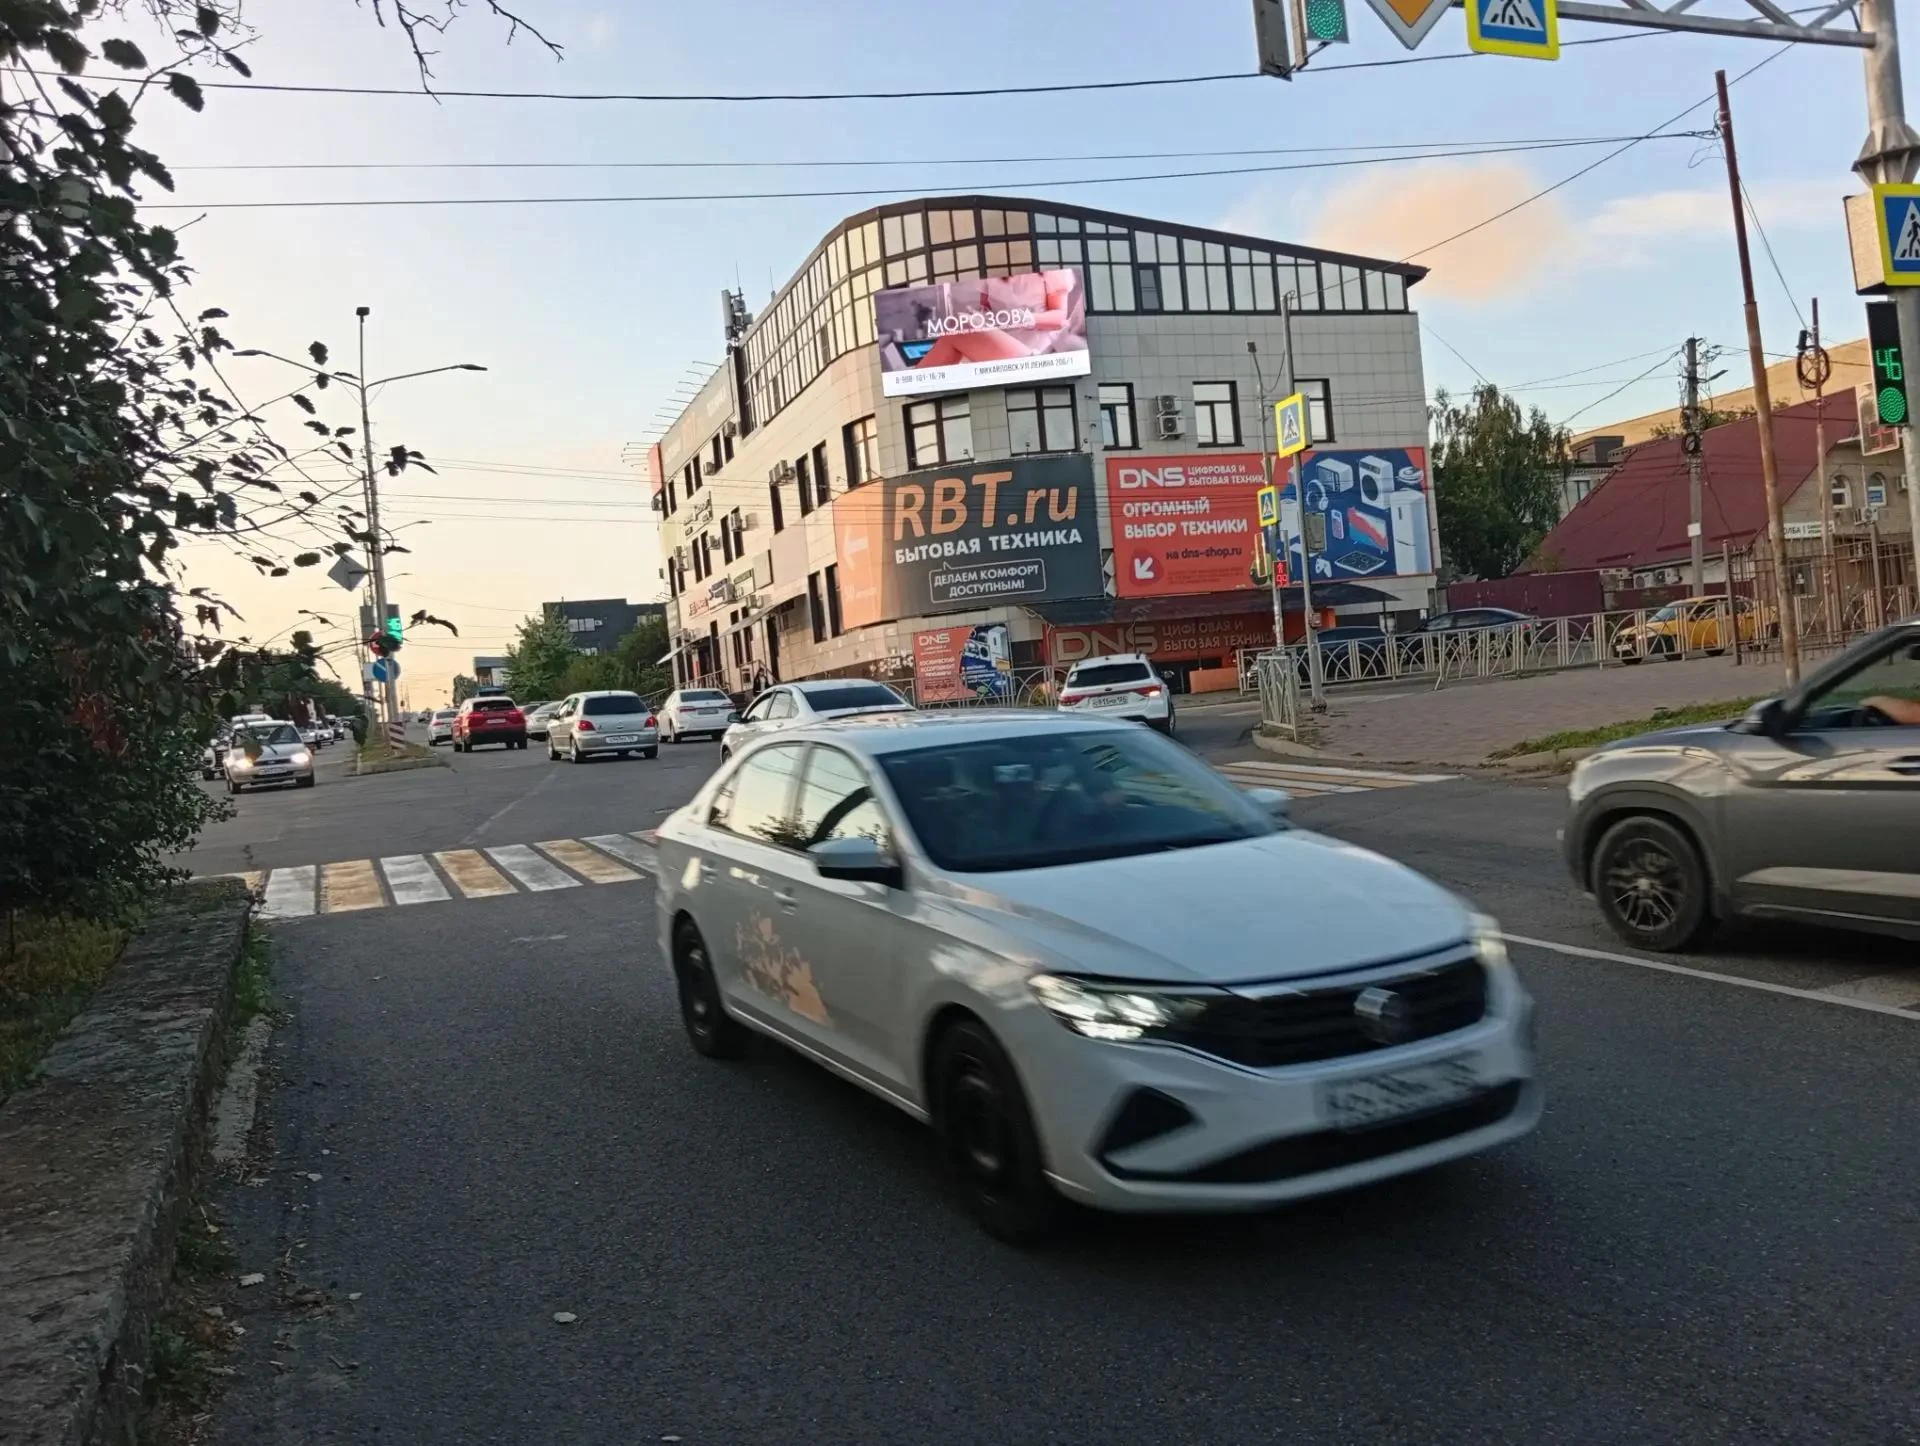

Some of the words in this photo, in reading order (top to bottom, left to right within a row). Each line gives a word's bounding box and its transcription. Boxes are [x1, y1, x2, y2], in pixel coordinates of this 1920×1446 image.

[927, 307, 1035, 334] МОРОЗОВА
[1875, 348, 1902, 380] 46
[1119, 467, 1185, 489] DNS
[1187, 465, 1236, 476] ЦИФРОВАЯ
[1238, 464, 1246, 473] И
[1188, 476, 1230, 486] БЫТОВАЯ
[893, 471, 1078, 541] RBT.ru
[1122, 496, 1211, 518] ОГРОМНЫЙ
[1124, 523, 1177, 539] ВЫБОР
[1180, 518, 1249, 535] ТЕХНИКИ
[895, 538, 981, 565] БЫТОВАЯ
[988, 528, 1083, 551] ТЕХНИКА
[1166, 551, 1179, 560] на
[1181, 546, 1242, 560] dns-shop.ru
[934, 570, 978, 588] ДЕЛАЕМ
[980, 564, 1039, 581] КОМФОРТ
[949, 579, 1025, 598] ДОСТУПНЫМ!
[918, 632, 951, 646] DNS
[1055, 625, 1158, 662] DNS
